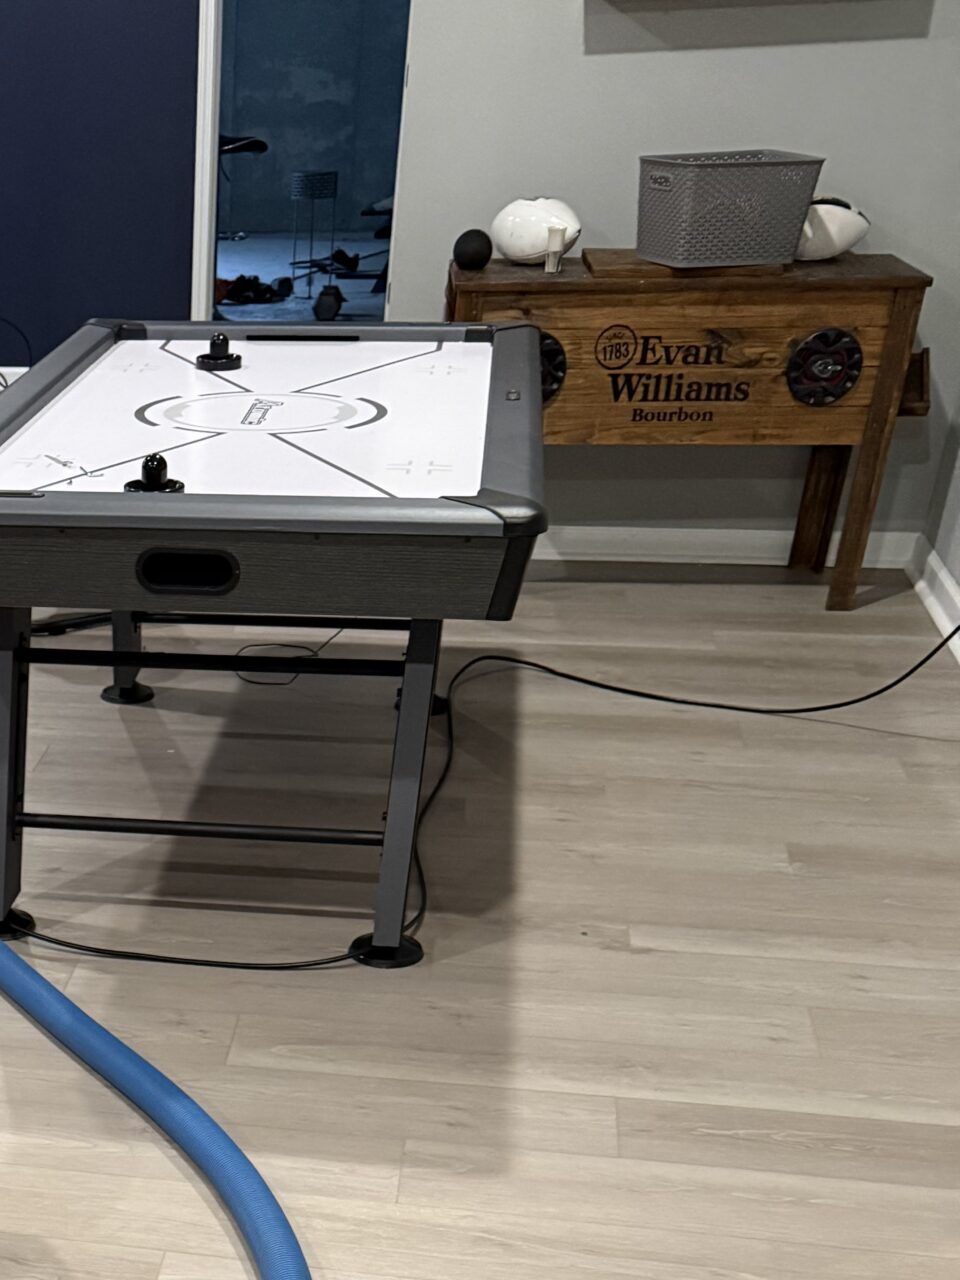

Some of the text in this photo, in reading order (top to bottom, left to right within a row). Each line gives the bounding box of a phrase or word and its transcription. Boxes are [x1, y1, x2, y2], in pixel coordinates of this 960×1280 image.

[603, 342, 630, 362] 1783
[636, 335, 726, 366] Evan
[607, 372, 751, 402] Williams
[632, 407, 714, 422] Bourbon
